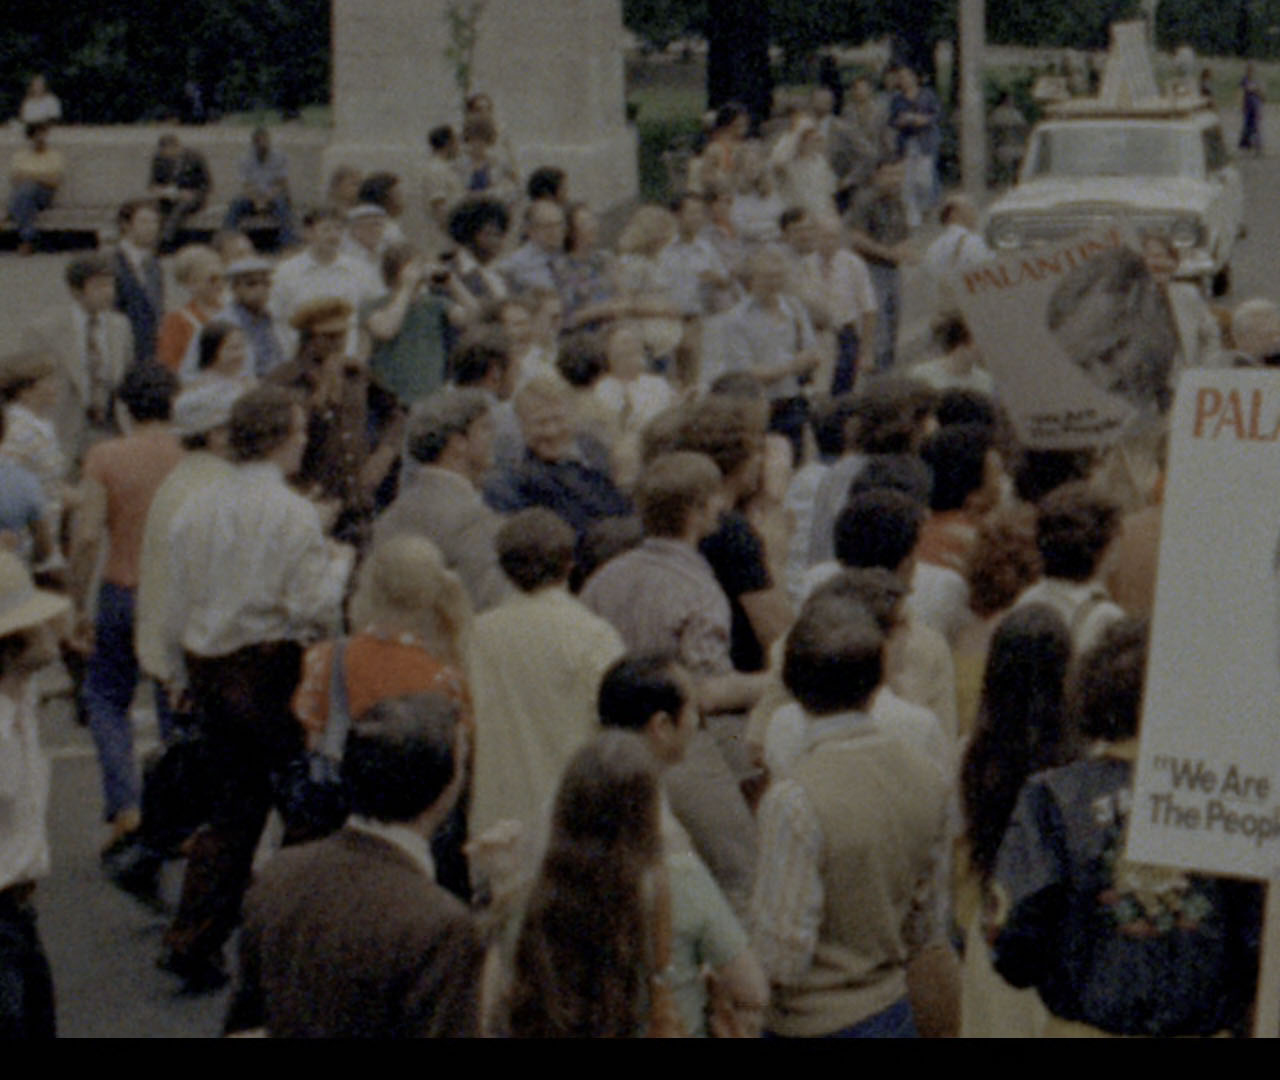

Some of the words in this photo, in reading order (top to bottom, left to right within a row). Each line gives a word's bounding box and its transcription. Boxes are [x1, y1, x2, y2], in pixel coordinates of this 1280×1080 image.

[1153, 757, 1217, 795] "We
[1222, 769, 1271, 799] Are
[1149, 793, 1203, 828] The
